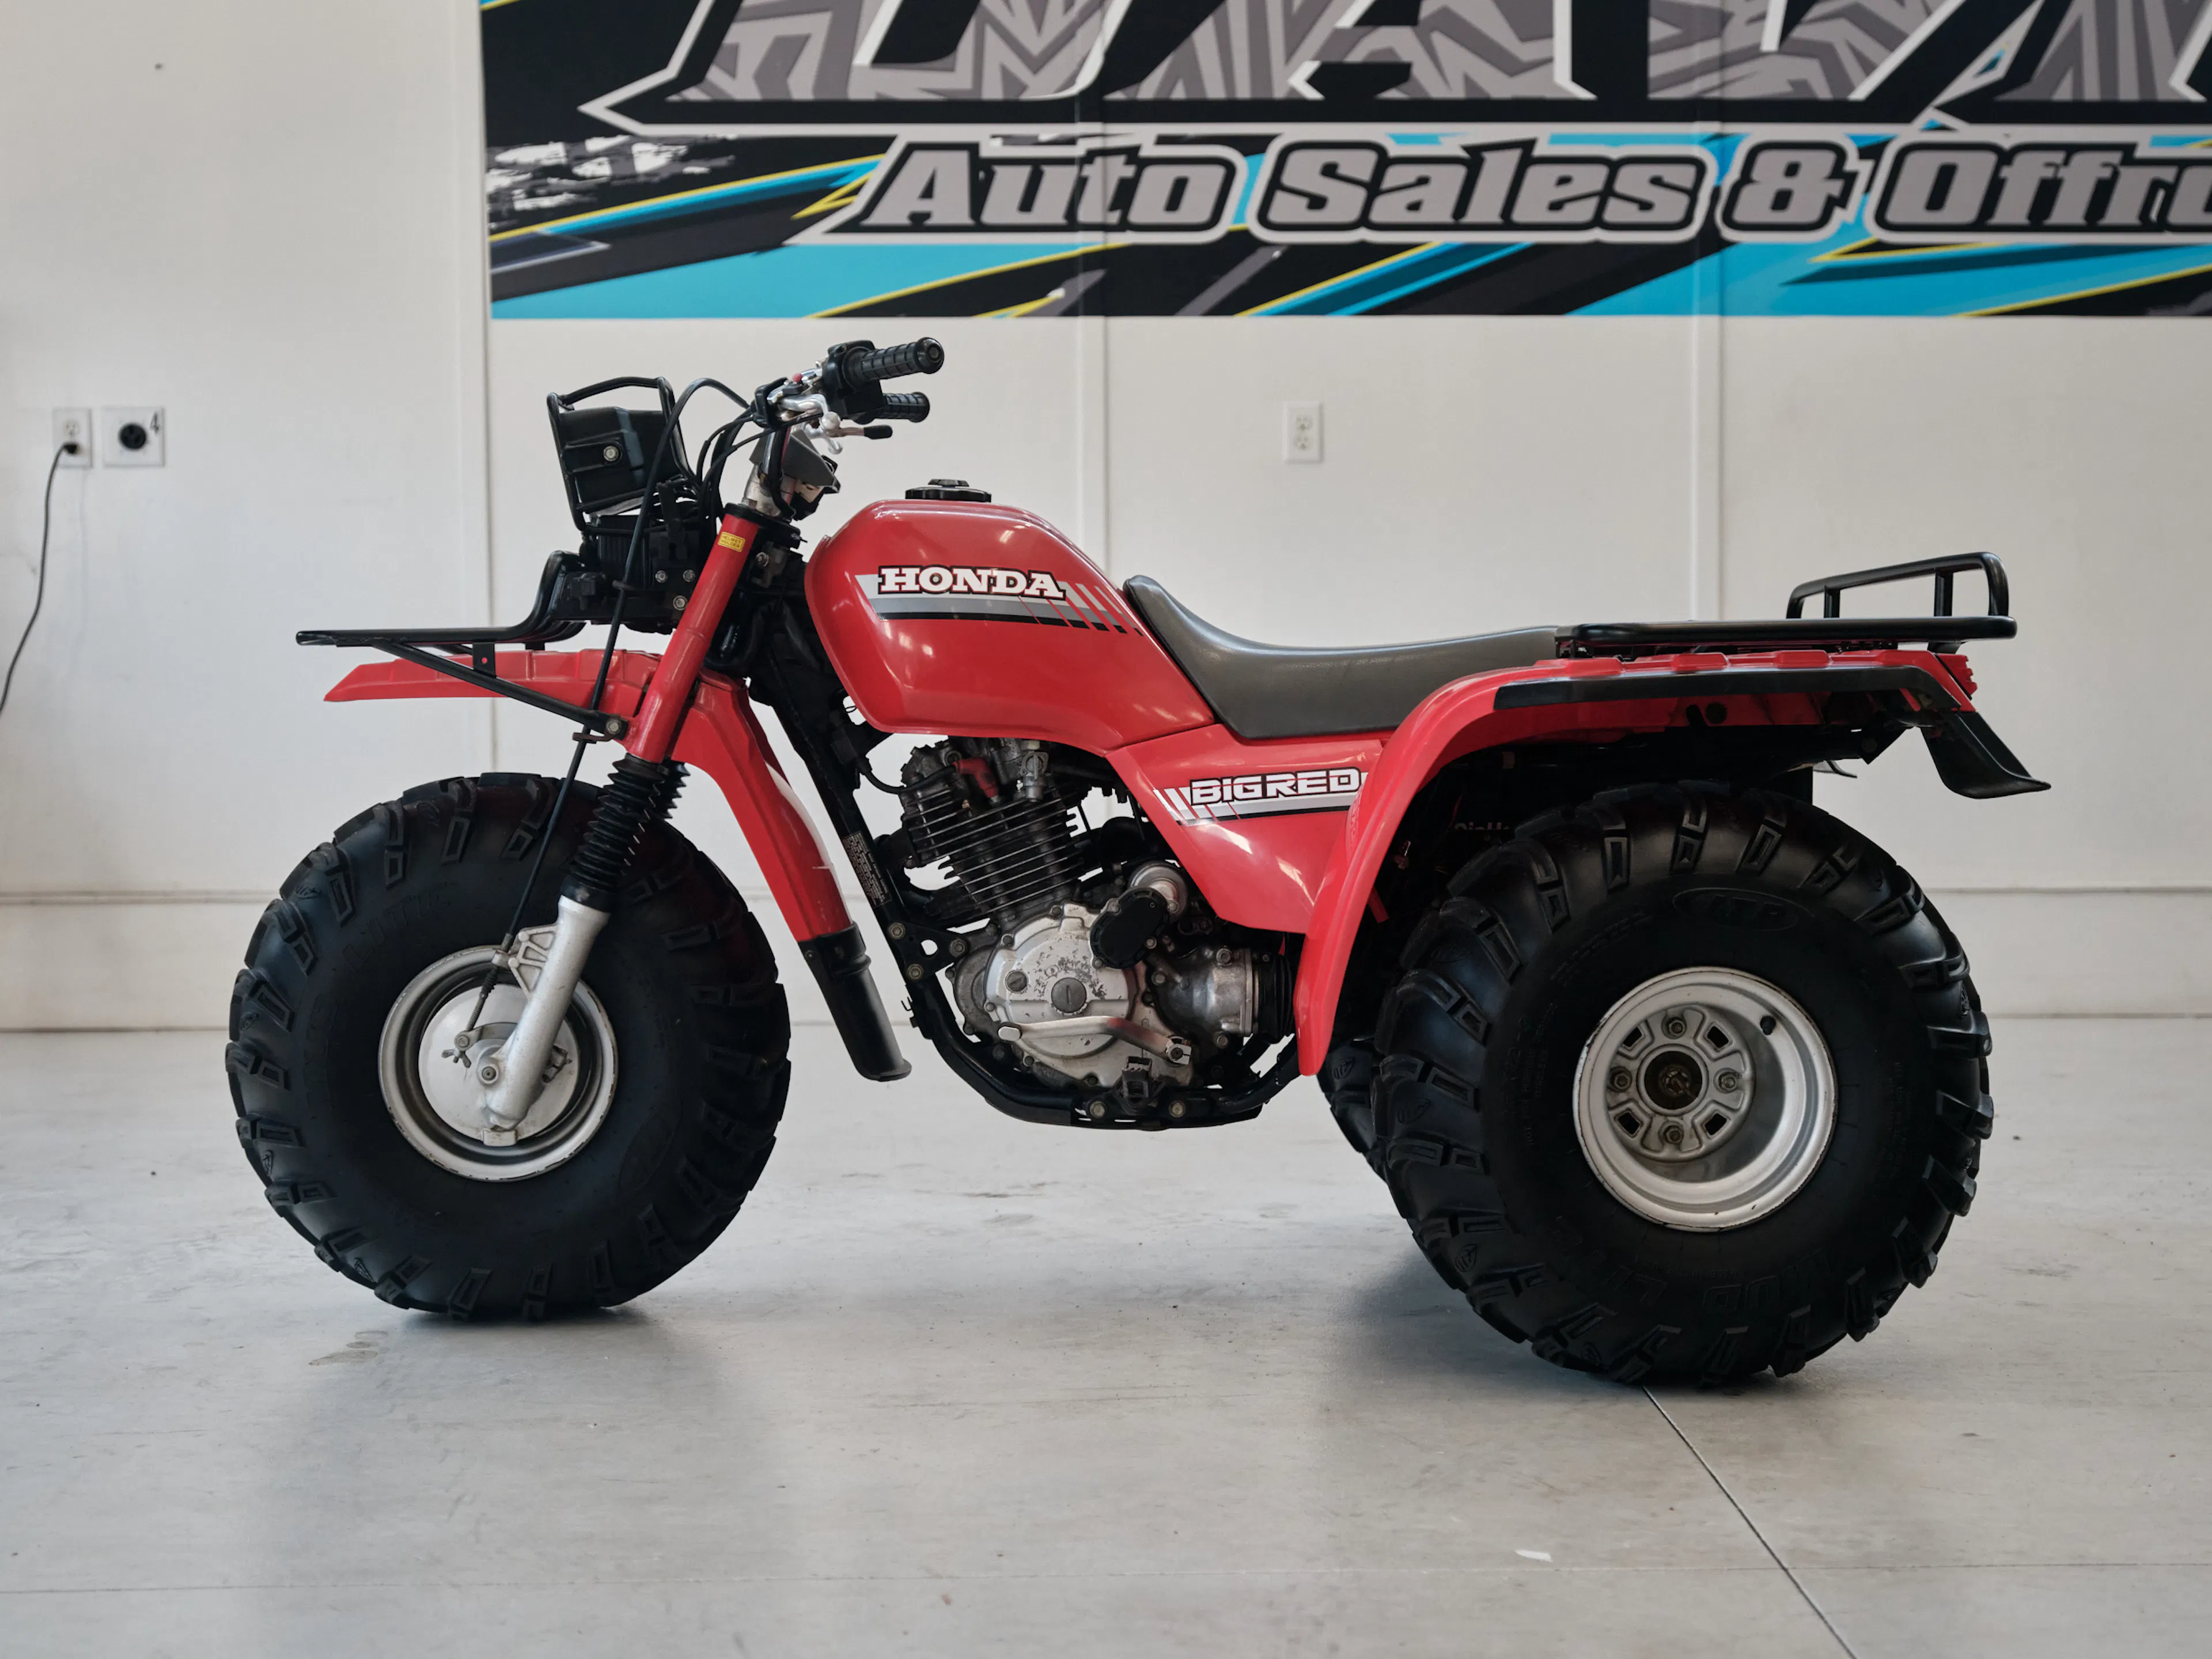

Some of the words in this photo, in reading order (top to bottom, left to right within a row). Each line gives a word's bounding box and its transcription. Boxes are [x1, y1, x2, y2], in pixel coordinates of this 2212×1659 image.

[858, 147, 1228, 227] Auto
[1265, 143, 1700, 228] Sales
[1729, 145, 1842, 228] &
[879, 566, 1065, 599] HONDA
